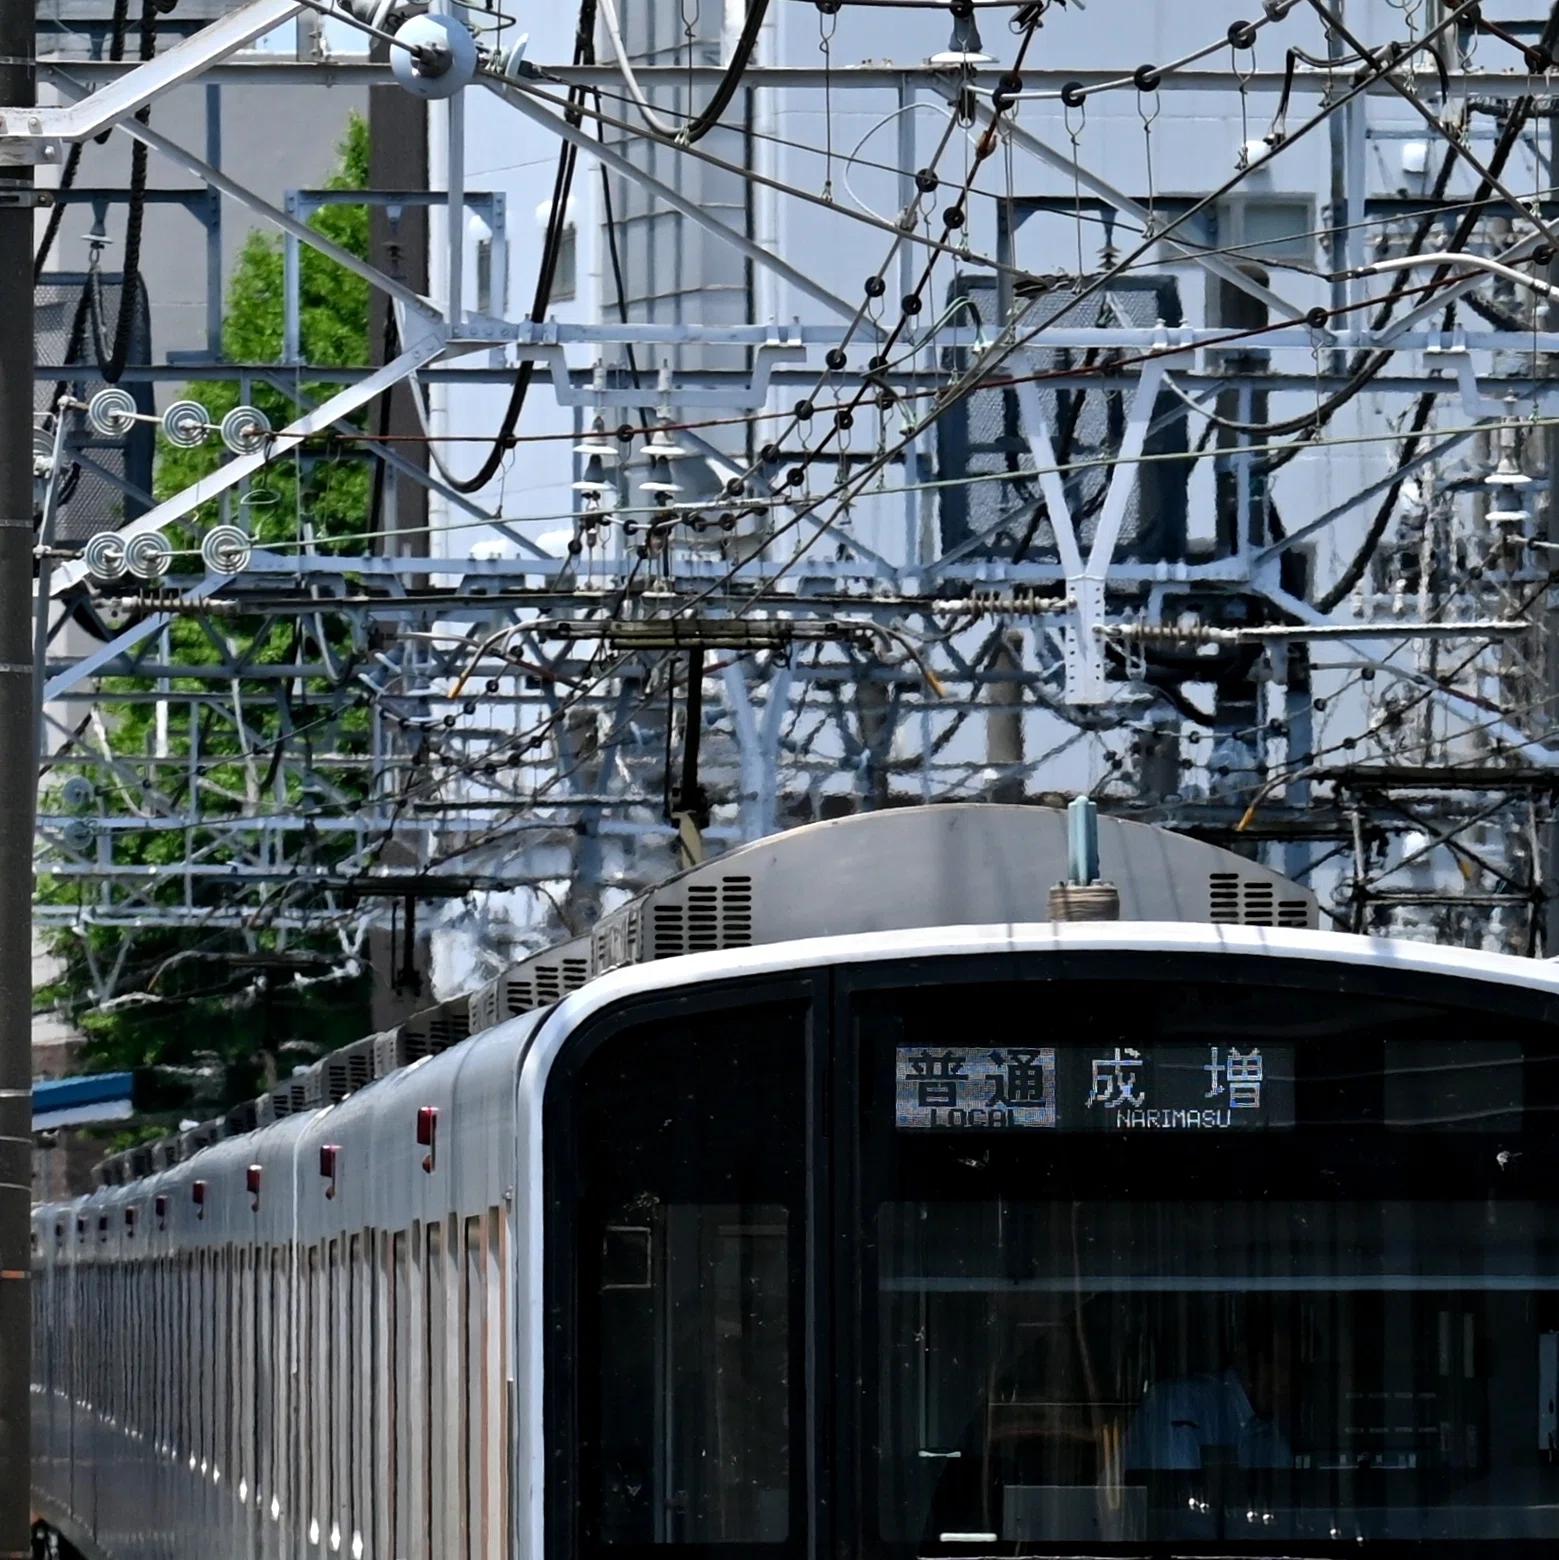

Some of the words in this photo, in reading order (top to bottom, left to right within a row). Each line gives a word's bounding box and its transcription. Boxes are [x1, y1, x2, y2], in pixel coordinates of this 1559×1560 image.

[905, 1048, 1047, 1108] 普通
[1085, 1046, 1262, 1109] 成増
[1117, 1108, 1231, 1129] NARIMASU
